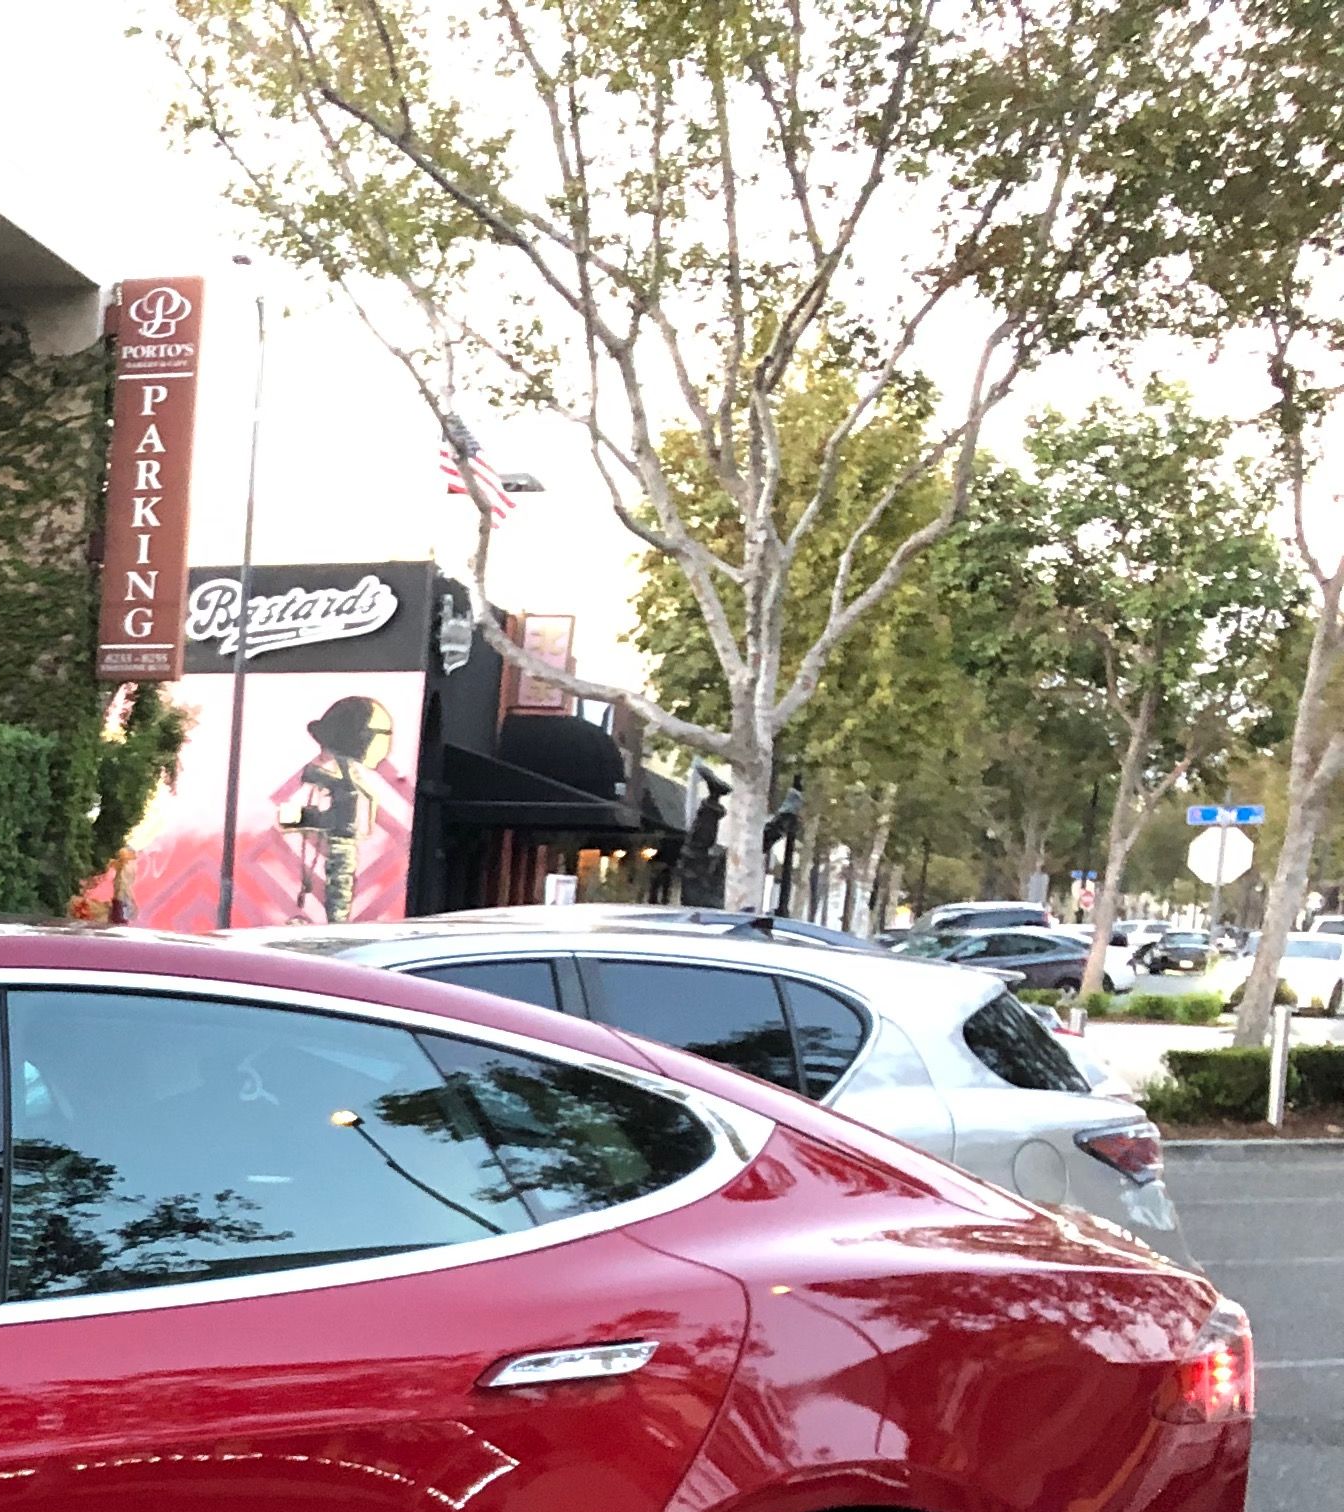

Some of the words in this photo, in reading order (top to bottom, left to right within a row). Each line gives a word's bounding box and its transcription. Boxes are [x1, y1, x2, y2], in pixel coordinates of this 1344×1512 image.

[122, 343, 194, 359] PORTO'S
[123, 385, 169, 639] PARKING
[188, 576, 392, 645] Bstards
